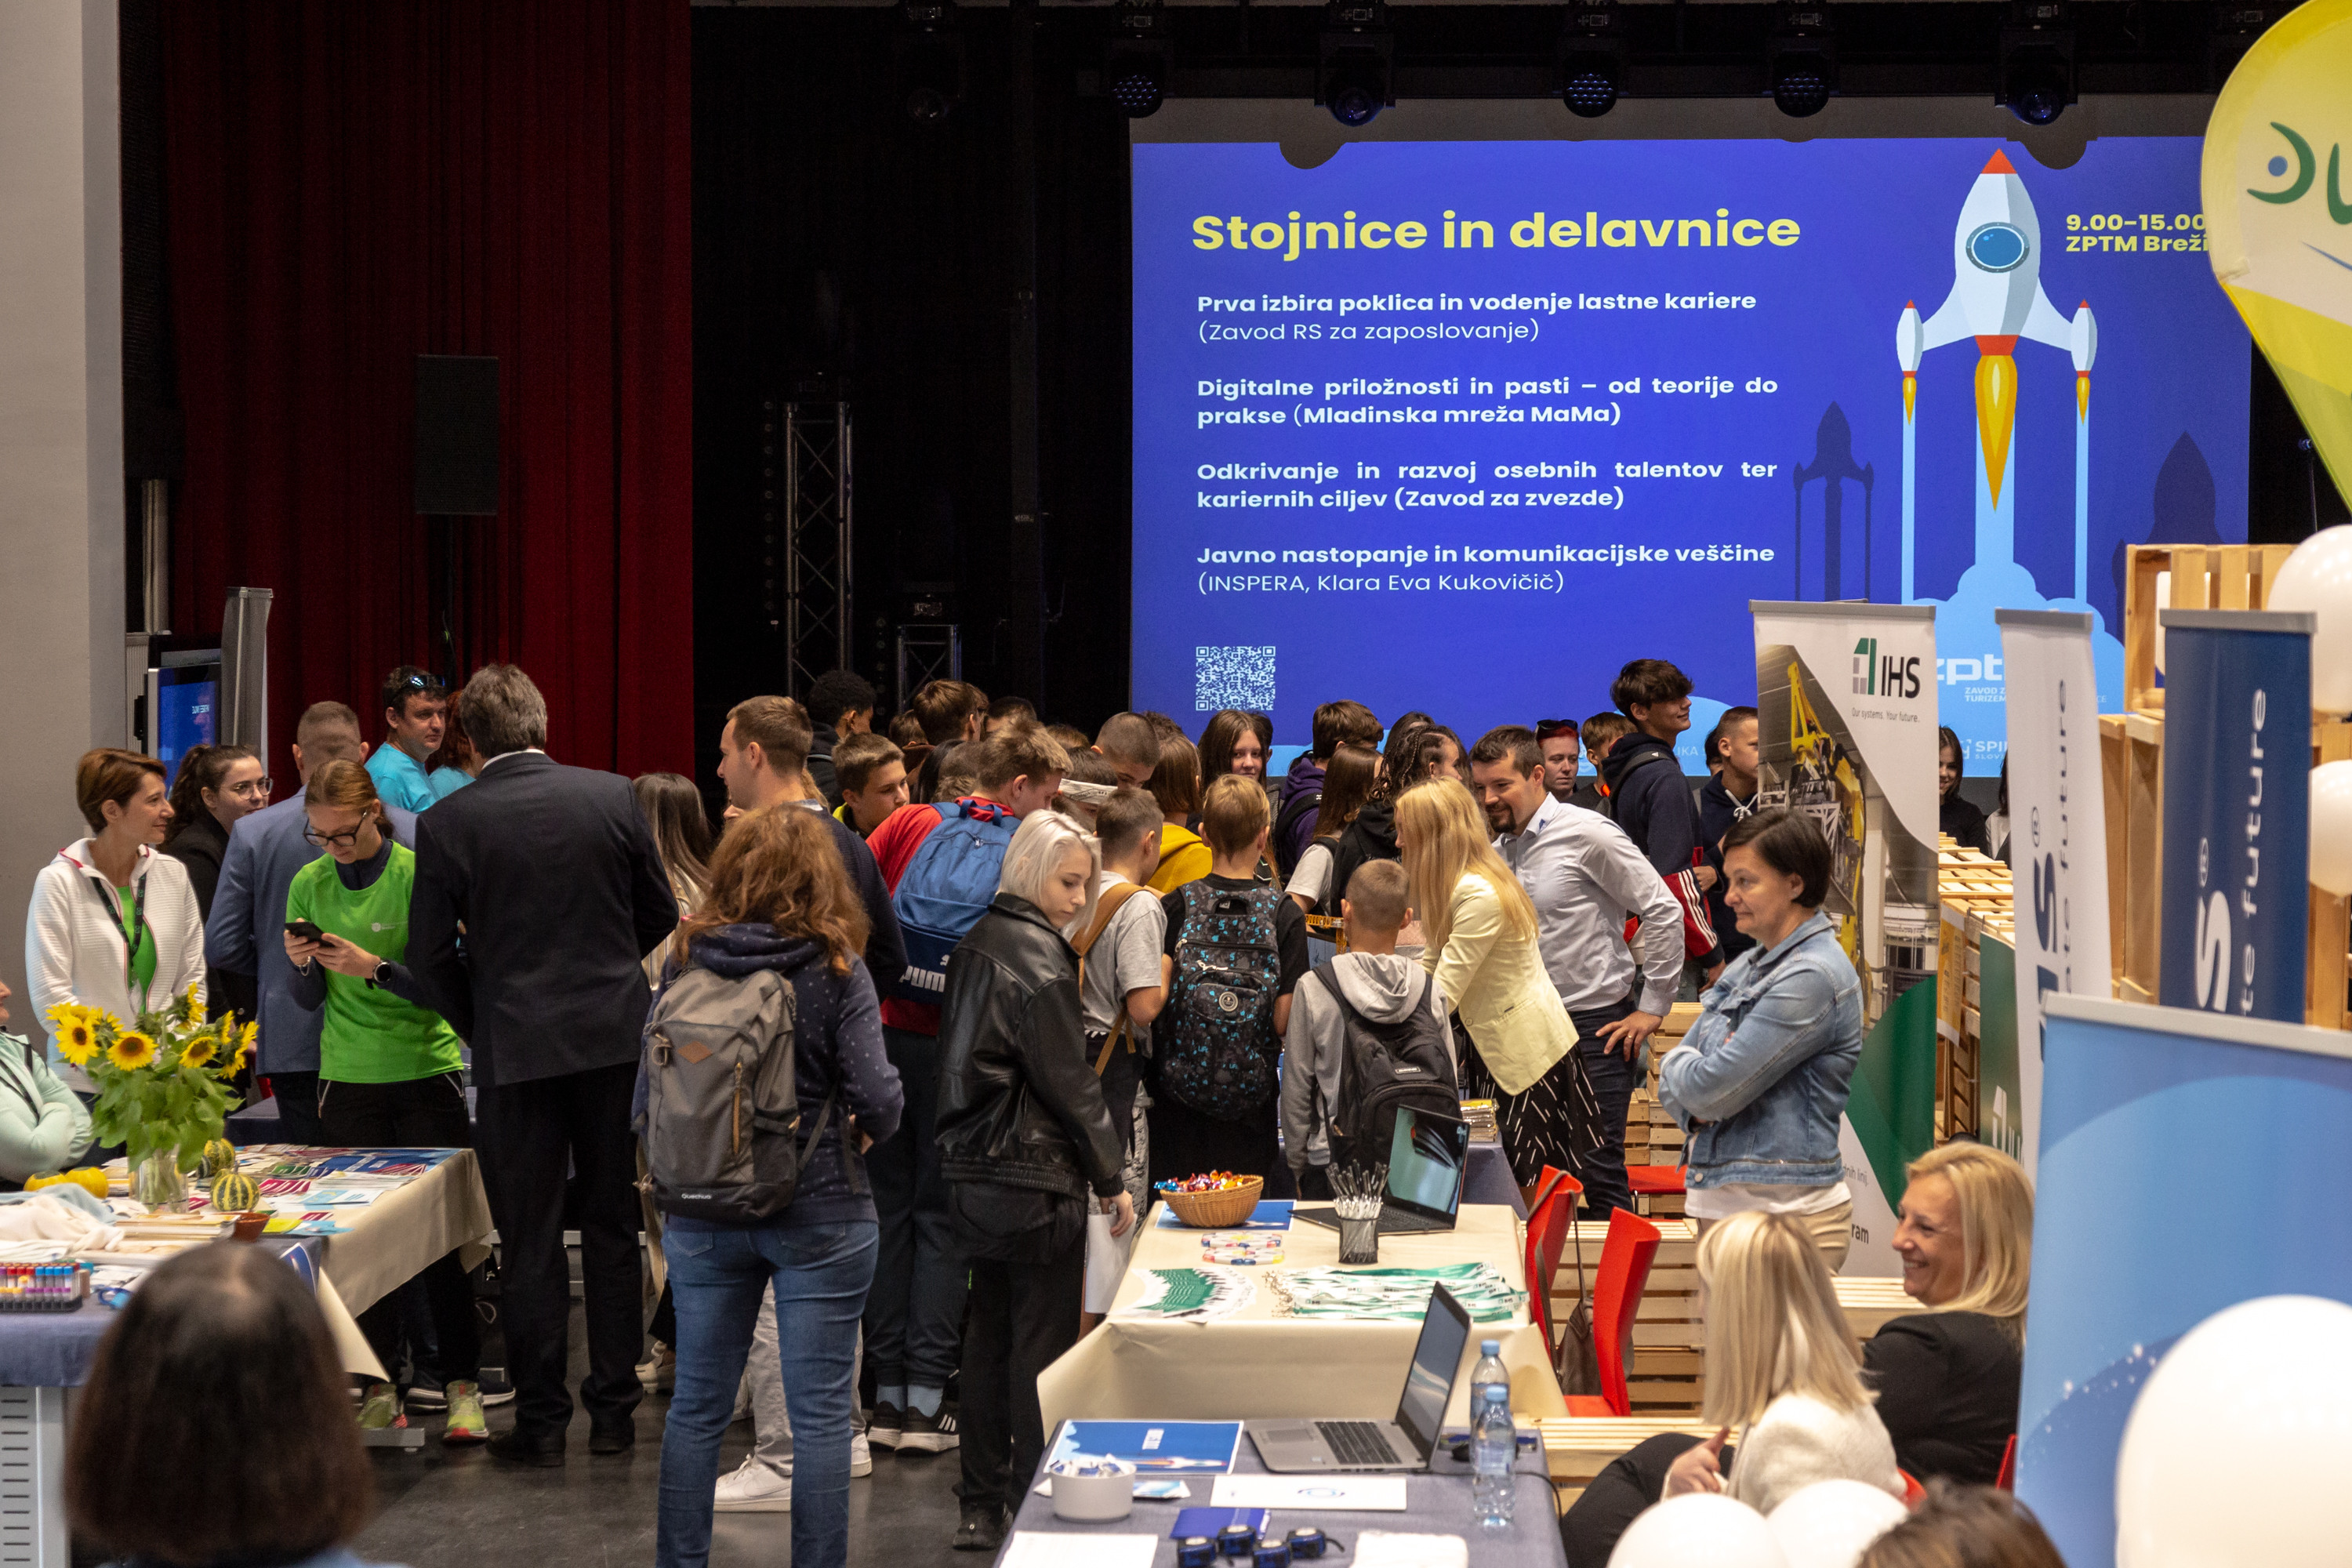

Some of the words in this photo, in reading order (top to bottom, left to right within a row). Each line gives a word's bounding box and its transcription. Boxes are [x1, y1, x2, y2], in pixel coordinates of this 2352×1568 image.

[1192, 211, 1428, 262] Stojnice
[1443, 210, 1495, 249] in
[1510, 209, 1802, 249] delavnice
[2066, 236, 2137, 252] ZPTM
[1198, 296, 1256, 312] Prva
[1263, 295, 1334, 311] izbira
[1340, 294, 1434, 318] poklica
[1440, 293, 1464, 311] in
[1469, 292, 1573, 316] vodenje
[1579, 293, 1660, 310] lastne
[1665, 292, 1758, 310] kariere
[1199, 321, 1286, 343] (Zavod
[1294, 325, 1323, 340] RS
[1330, 326, 1358, 340] za
[1365, 319, 1541, 343] zaposlovanje)
[1198, 379, 1315, 401] Digitalne
[1326, 377, 1460, 401] priložnosti
[1471, 377, 1494, 395] in
[1506, 377, 1571, 401] pasti
[1609, 377, 1642, 394] od
[1652, 376, 1735, 400] teorije
[1746, 376, 1779, 394] do
[1198, 406, 1287, 430] prakse
[1294, 404, 1438, 427] (Mladinska
[1445, 406, 1525, 423] mreža
[1531, 402, 1621, 426] MaMa)
[1198, 462, 1340, 486] Odkrivanje
[1357, 461, 1381, 480] in
[1399, 461, 1478, 485] razvoj
[1494, 461, 1598, 479] osebnih
[1615, 461, 1724, 479] talentov
[1741, 462, 1778, 478] ter
[1198, 490, 1315, 508] kariernih
[1320, 489, 1388, 512] ciljev
[1395, 488, 1486, 511] (Zavod
[1491, 493, 1520, 507] za
[1526, 486, 1625, 510] zvezde)
[1198, 547, 1277, 564] Javno
[1283, 546, 1429, 568] nastopanje
[1435, 546, 1458, 563] in
[1465, 544, 1671, 568] komunikacijske
[1675, 543, 1776, 562] veščine
[1199, 572, 1311, 596] (INSPERA,
[1318, 574, 1381, 591] Klara
[1388, 574, 1431, 591] Eva
[1439, 569, 1566, 593] Kukovičič)
[1881, 655, 1921, 699] IHS
[1975, 740, 2007, 753] SPI
[2241, 688, 2267, 918] future
